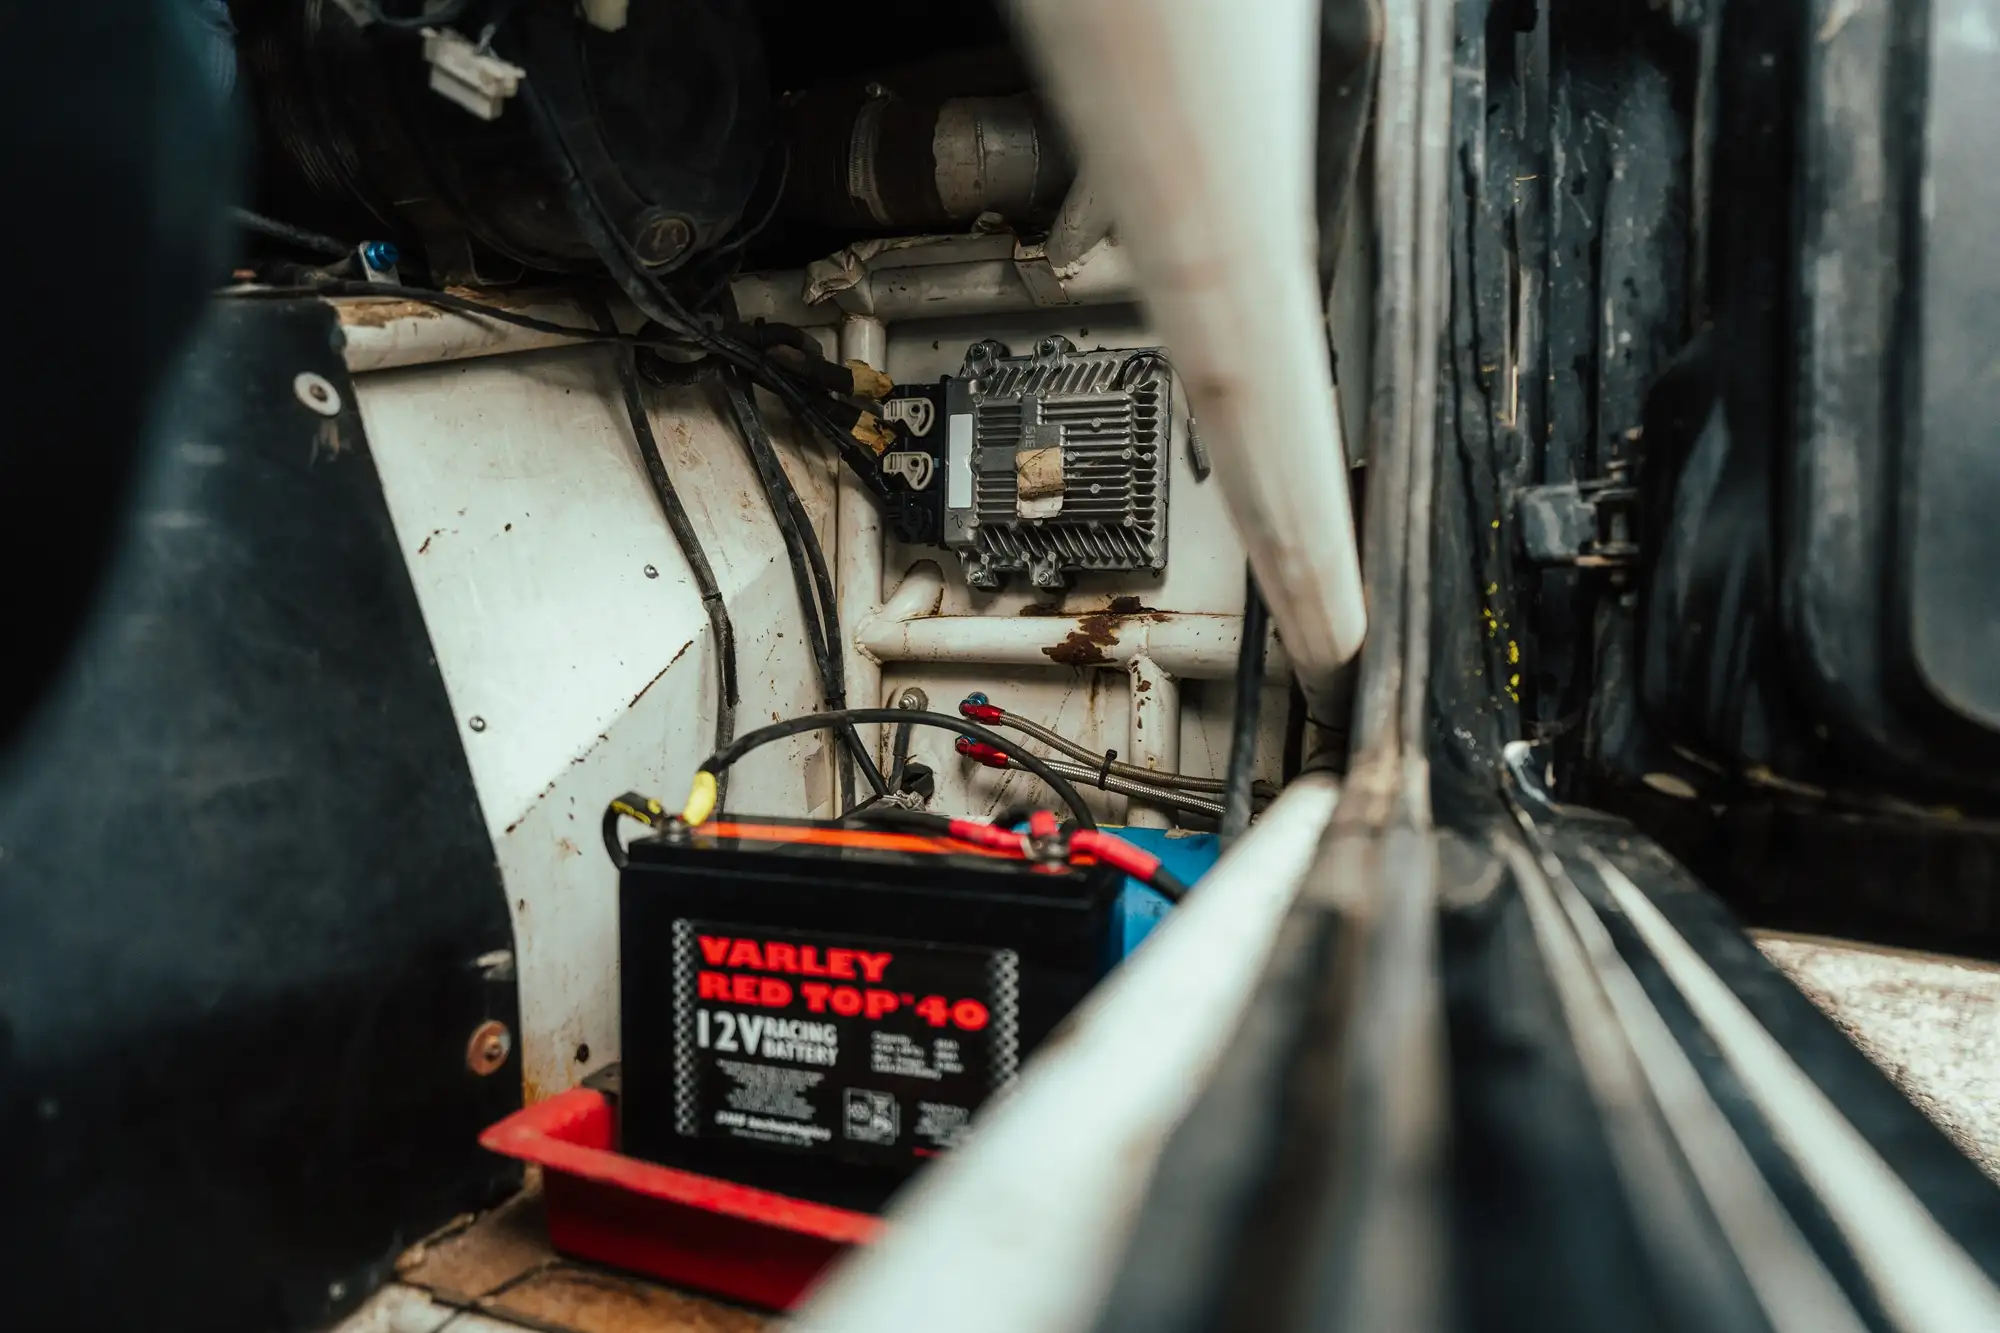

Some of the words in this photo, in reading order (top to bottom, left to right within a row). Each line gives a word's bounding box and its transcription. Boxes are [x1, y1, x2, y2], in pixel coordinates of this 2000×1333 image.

[699, 935, 893, 982] VARLEY
[698, 971, 793, 1008] RED
[915, 995, 989, 1031] 40
[697, 1008, 764, 1056] 12V
[761, 1037, 839, 1067] BATTERY
[762, 1016, 838, 1047] RACING
